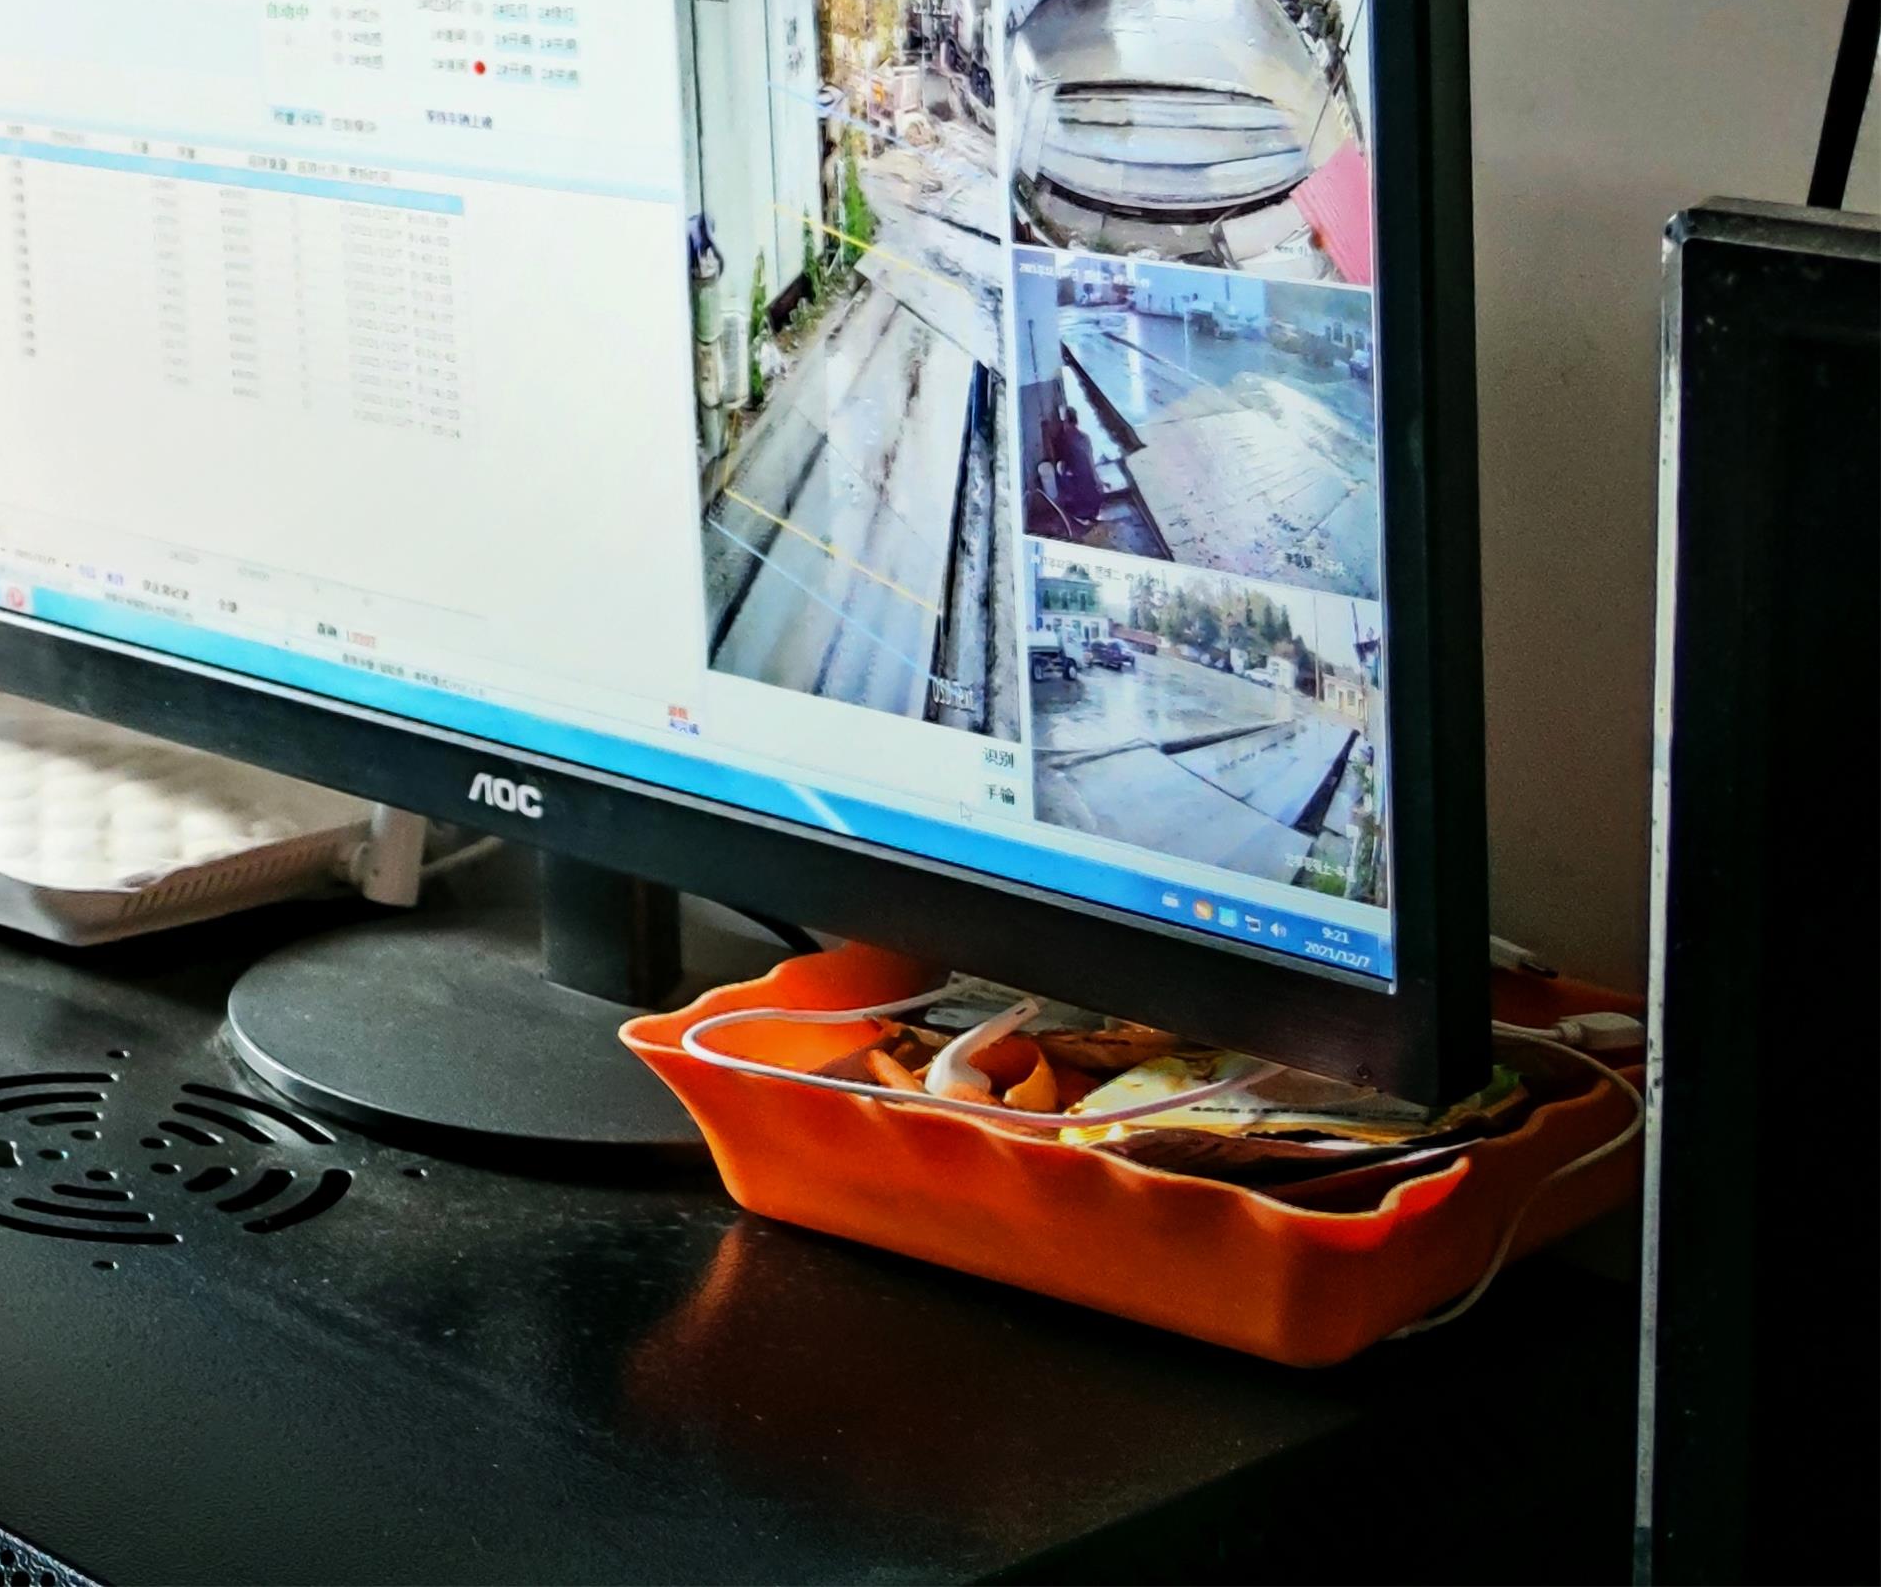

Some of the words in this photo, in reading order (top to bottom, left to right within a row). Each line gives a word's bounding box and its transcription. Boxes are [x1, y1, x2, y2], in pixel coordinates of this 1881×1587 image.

[983, 747, 1014, 769] 识别
[468, 772, 543, 819] AOC
[1322, 927, 1349, 943] 9:21
[1305, 941, 1370, 967] 2021/12/7
